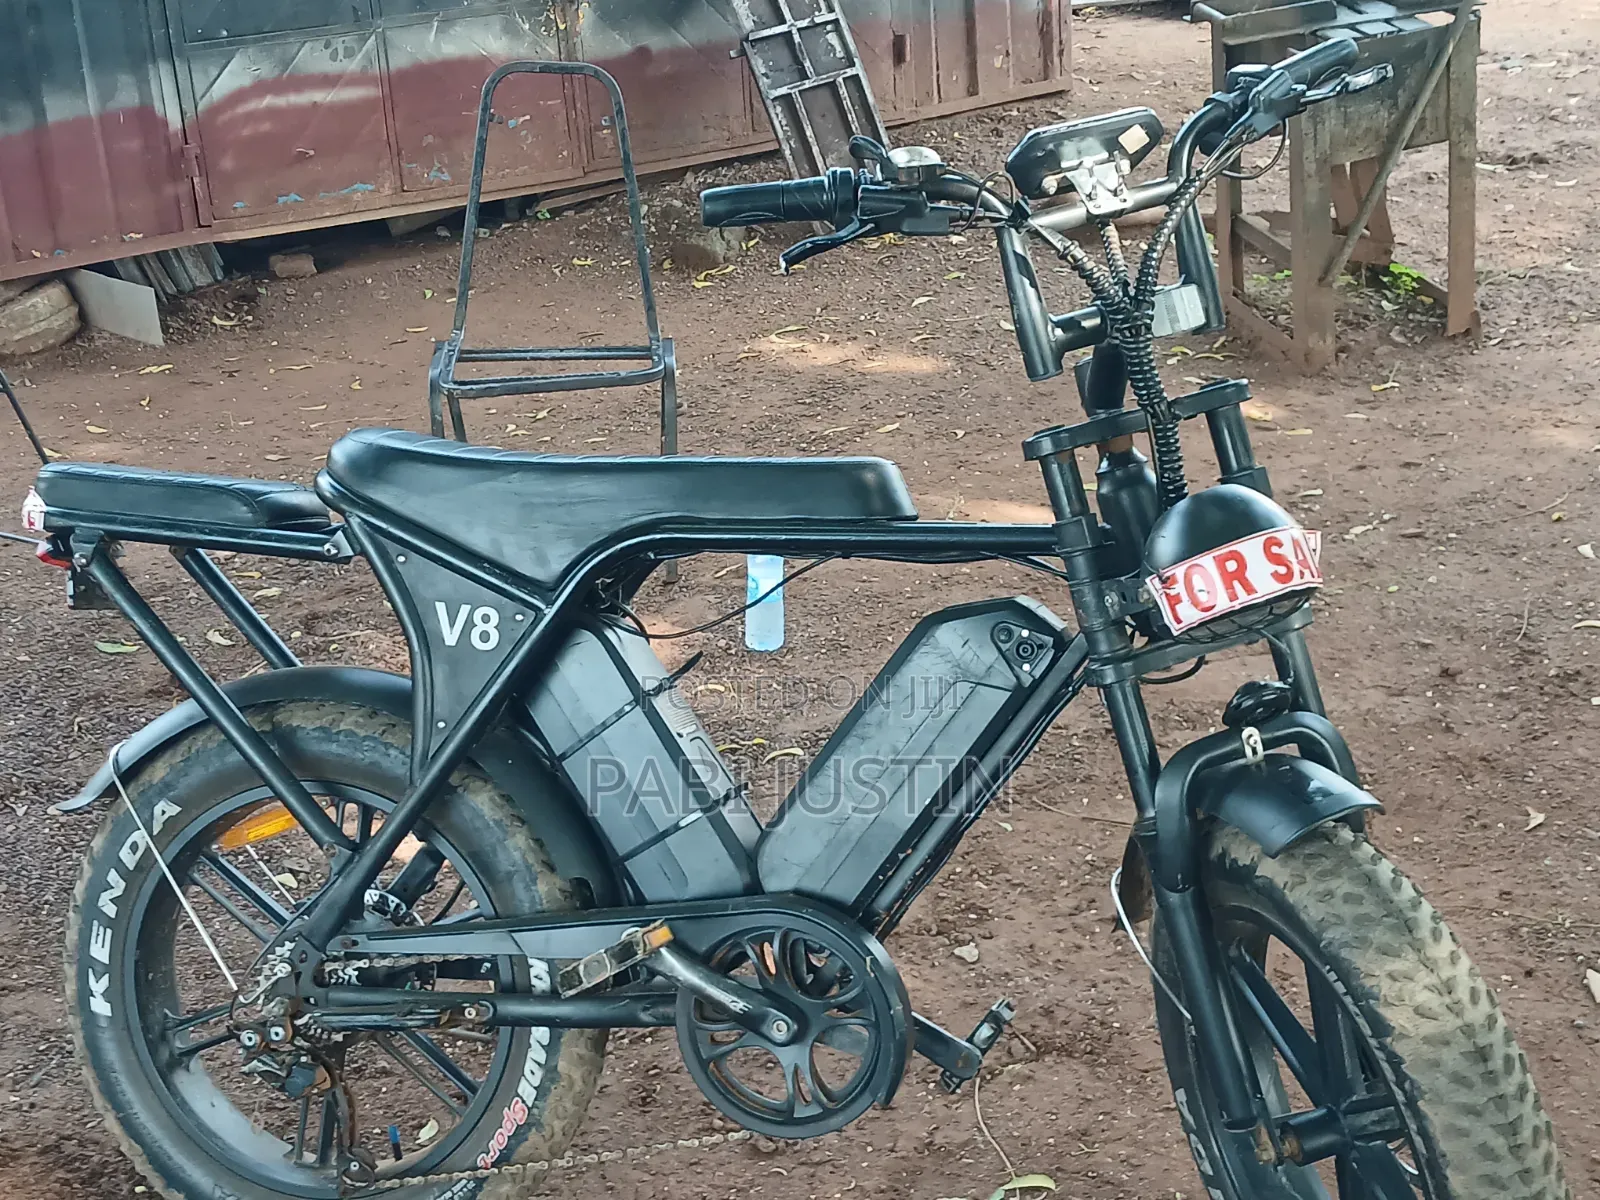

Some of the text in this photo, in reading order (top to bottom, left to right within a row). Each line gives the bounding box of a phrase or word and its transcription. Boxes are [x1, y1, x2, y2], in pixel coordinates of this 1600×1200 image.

[1161, 535, 1323, 625] FOR SA
[434, 601, 500, 651] V8
[88, 798, 183, 1017] KENDA
